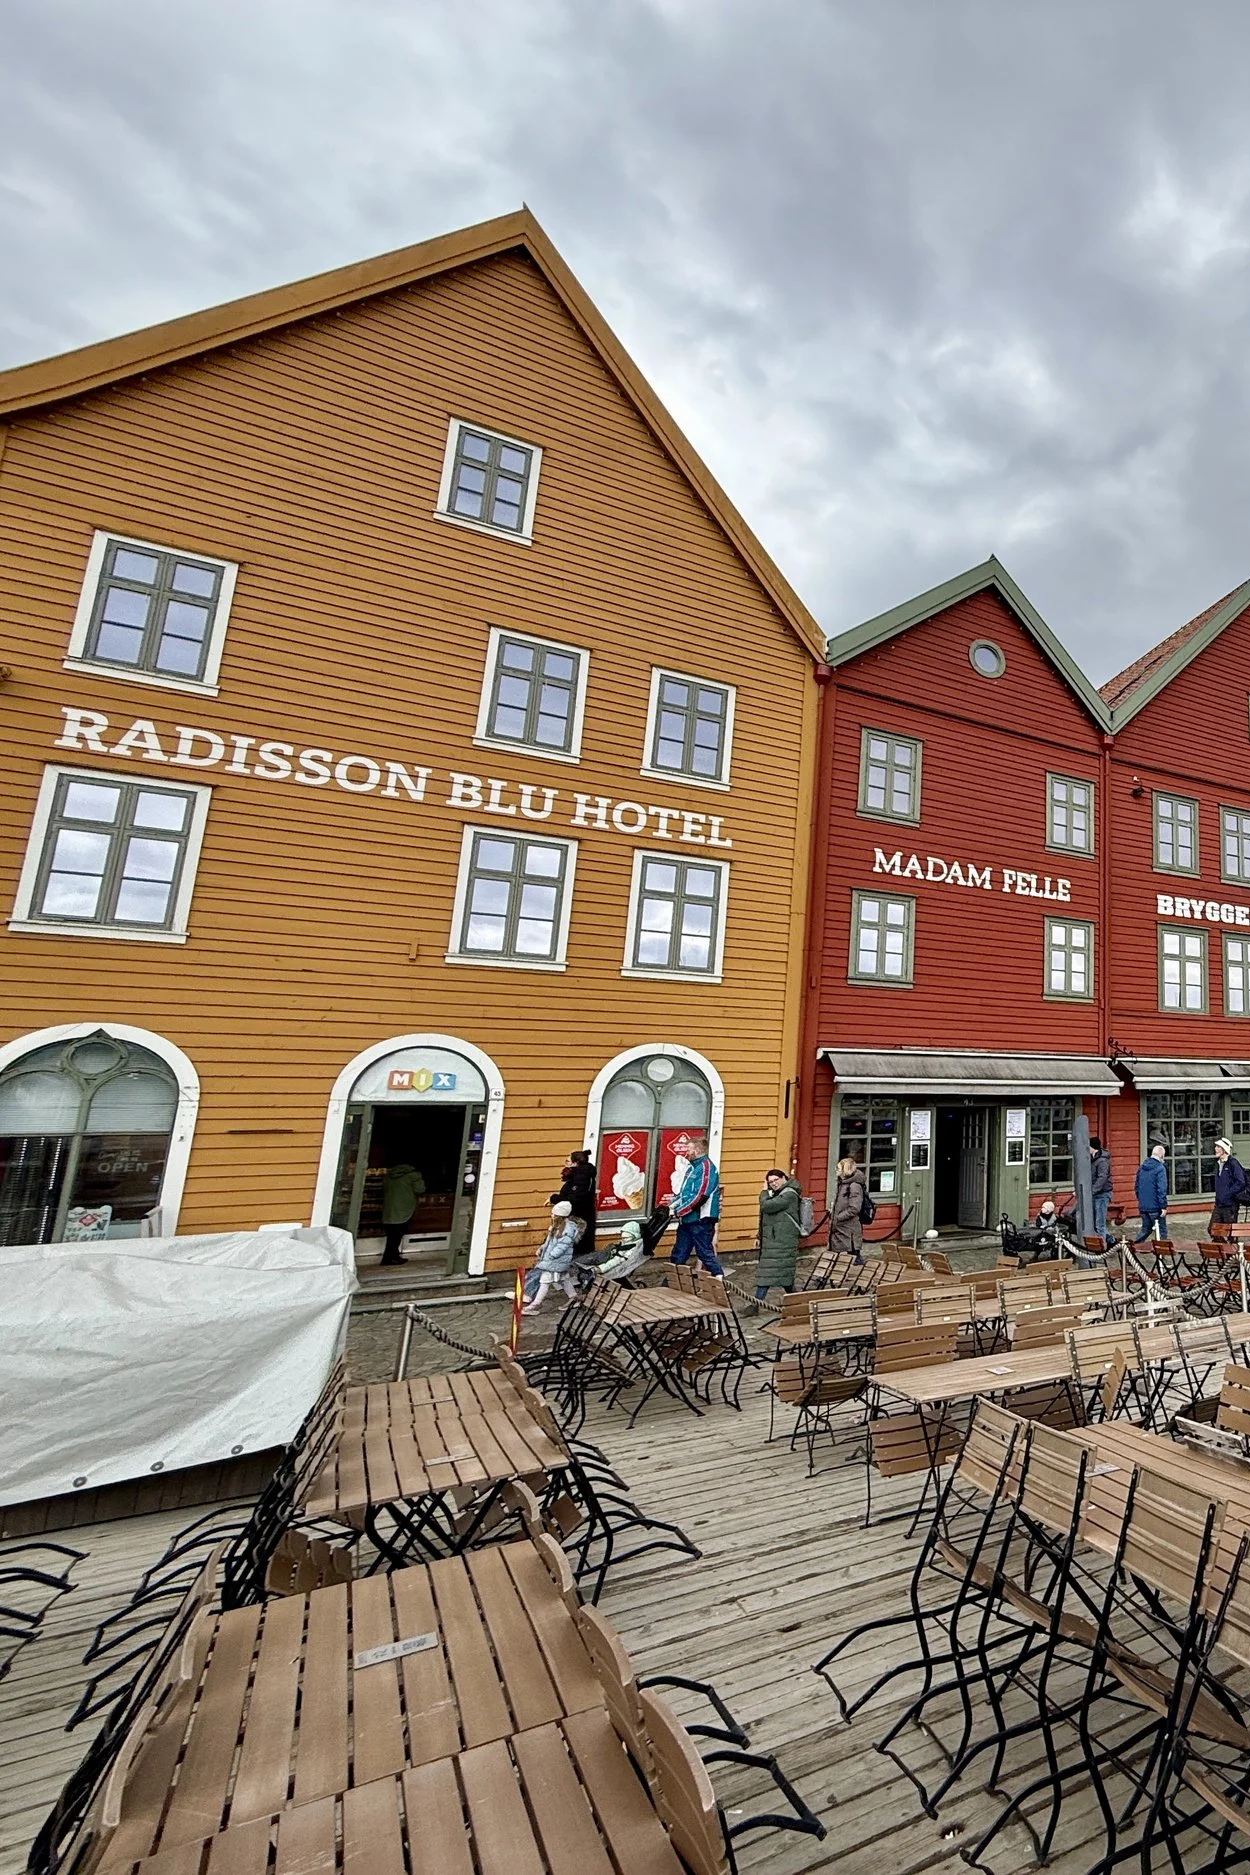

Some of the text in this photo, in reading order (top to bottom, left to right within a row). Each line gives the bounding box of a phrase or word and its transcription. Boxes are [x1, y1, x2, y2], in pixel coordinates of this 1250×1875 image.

[54, 707, 732, 847] RADISSON BLU HOTEL
[872, 848, 1072, 902] MADAM FELLE
[392, 1073, 451, 1086] MIX
[97, 1162, 148, 1173] OPEN
